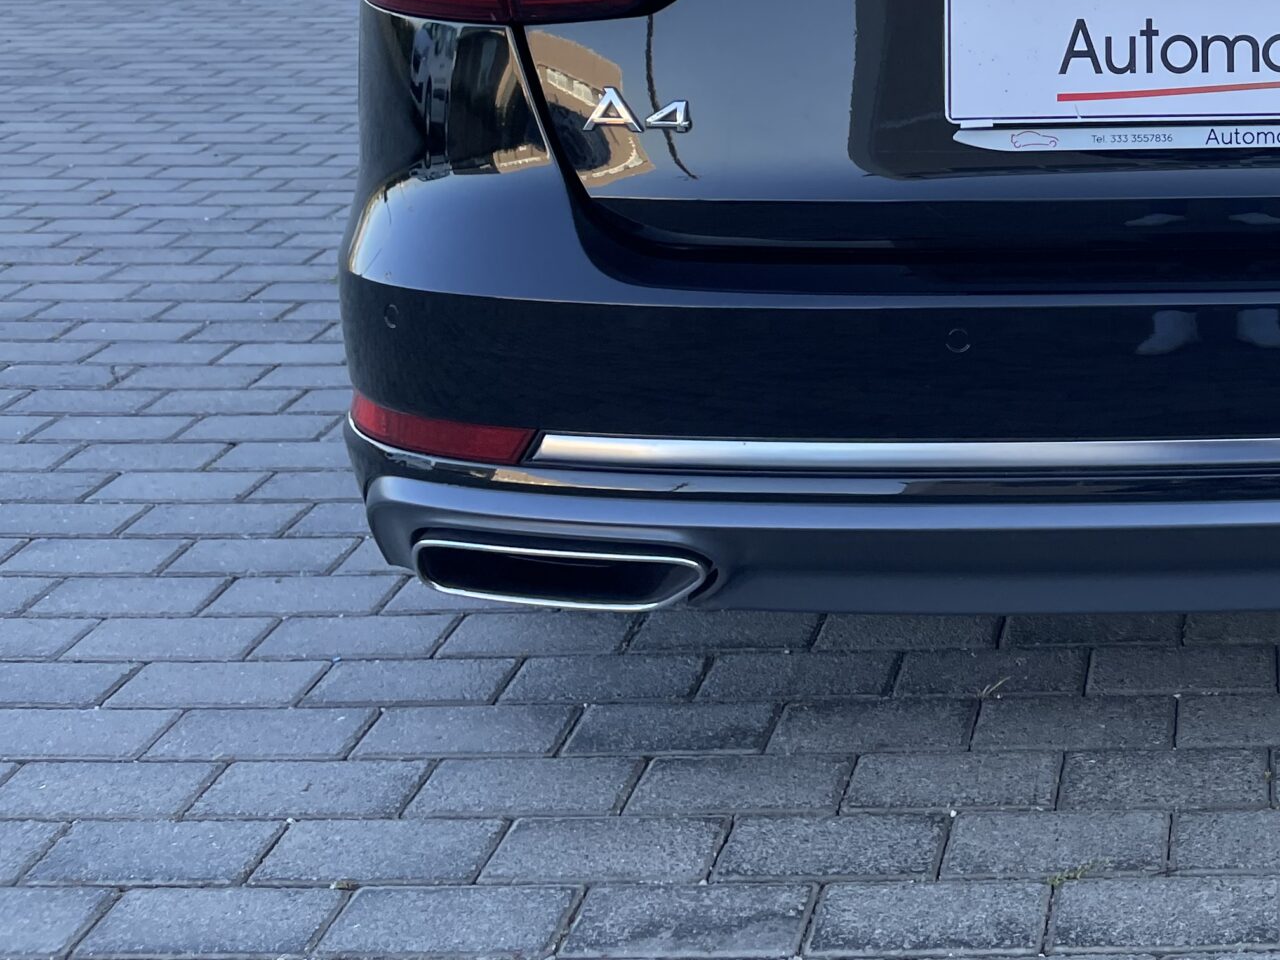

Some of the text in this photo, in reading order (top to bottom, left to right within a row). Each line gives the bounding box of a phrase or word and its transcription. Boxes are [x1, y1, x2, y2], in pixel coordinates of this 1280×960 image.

[582, 86, 692, 132] A4
[1091, 133, 1173, 143] Tel. 333 3557836
